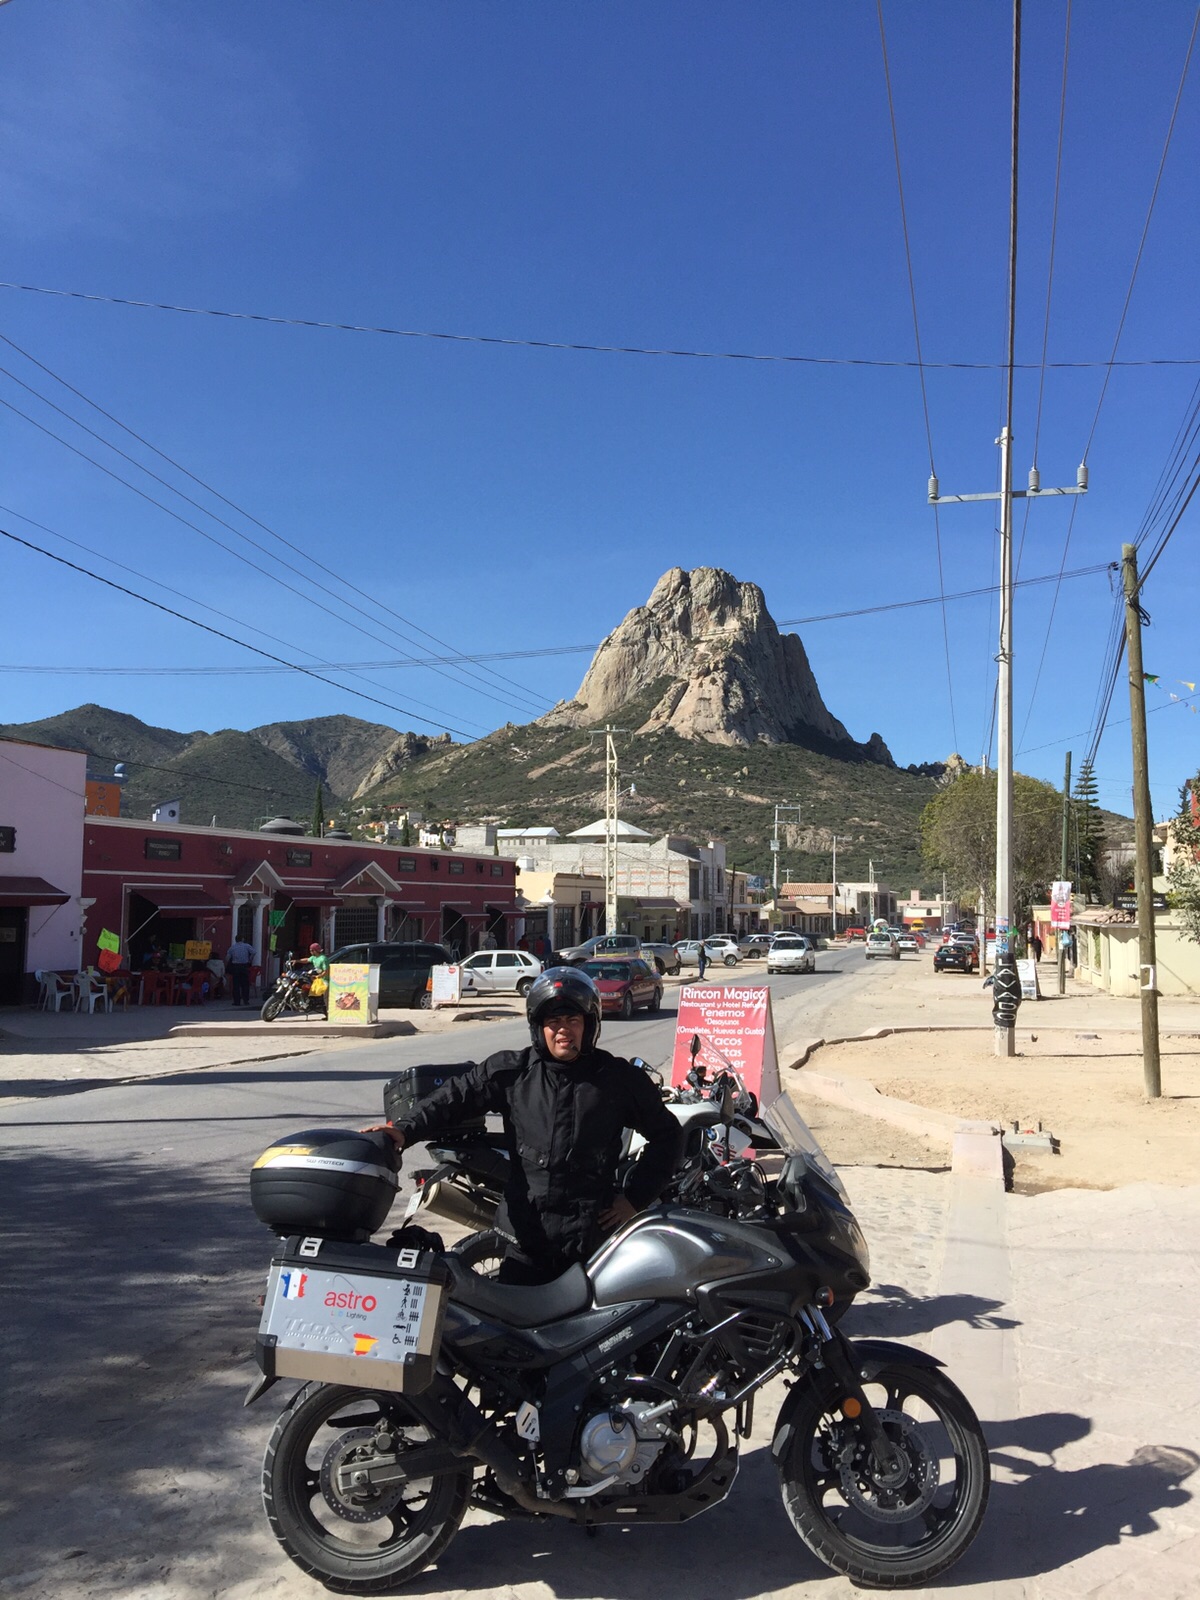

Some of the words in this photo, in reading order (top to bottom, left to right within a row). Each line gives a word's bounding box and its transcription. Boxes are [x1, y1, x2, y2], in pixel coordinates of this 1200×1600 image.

[682, 987, 721, 999] Rincon
[724, 987, 766, 1001] Magico
[996, 958, 1018, 1021] LAVADO
[700, 1008, 745, 1017] Tenemos
[713, 1027, 736, 1035] Huevos
[707, 1035, 743, 1046] Tacos
[324, 1290, 377, 1312] astro
[346, 1311, 368, 1321] Lighting
